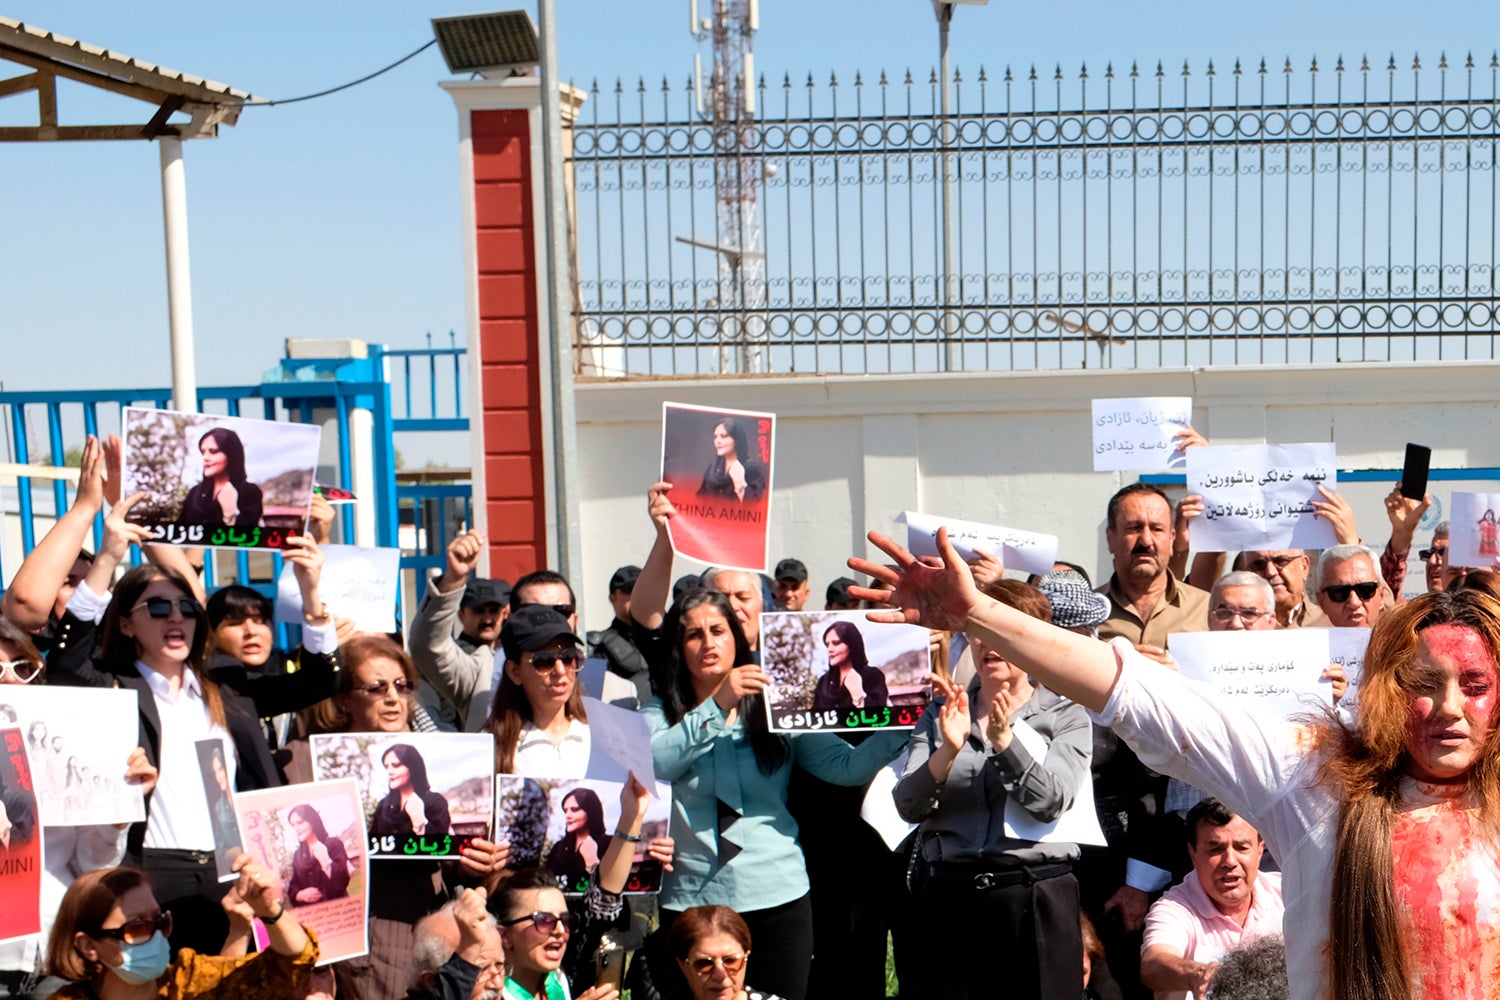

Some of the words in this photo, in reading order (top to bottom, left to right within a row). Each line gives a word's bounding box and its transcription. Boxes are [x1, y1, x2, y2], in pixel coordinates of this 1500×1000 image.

[1096, 411, 1131, 427] ئازادی
[671, 502, 715, 519] ZHINA
[719, 507, 761, 523] AMINI
[210, 527, 261, 547] ژیان
[777, 710, 840, 731] ئازادی
[845, 707, 892, 728] ژیان
[368, 835, 396, 855] ئاز
[403, 835, 452, 856] ژیان
[0, 857, 33, 875] MINI
